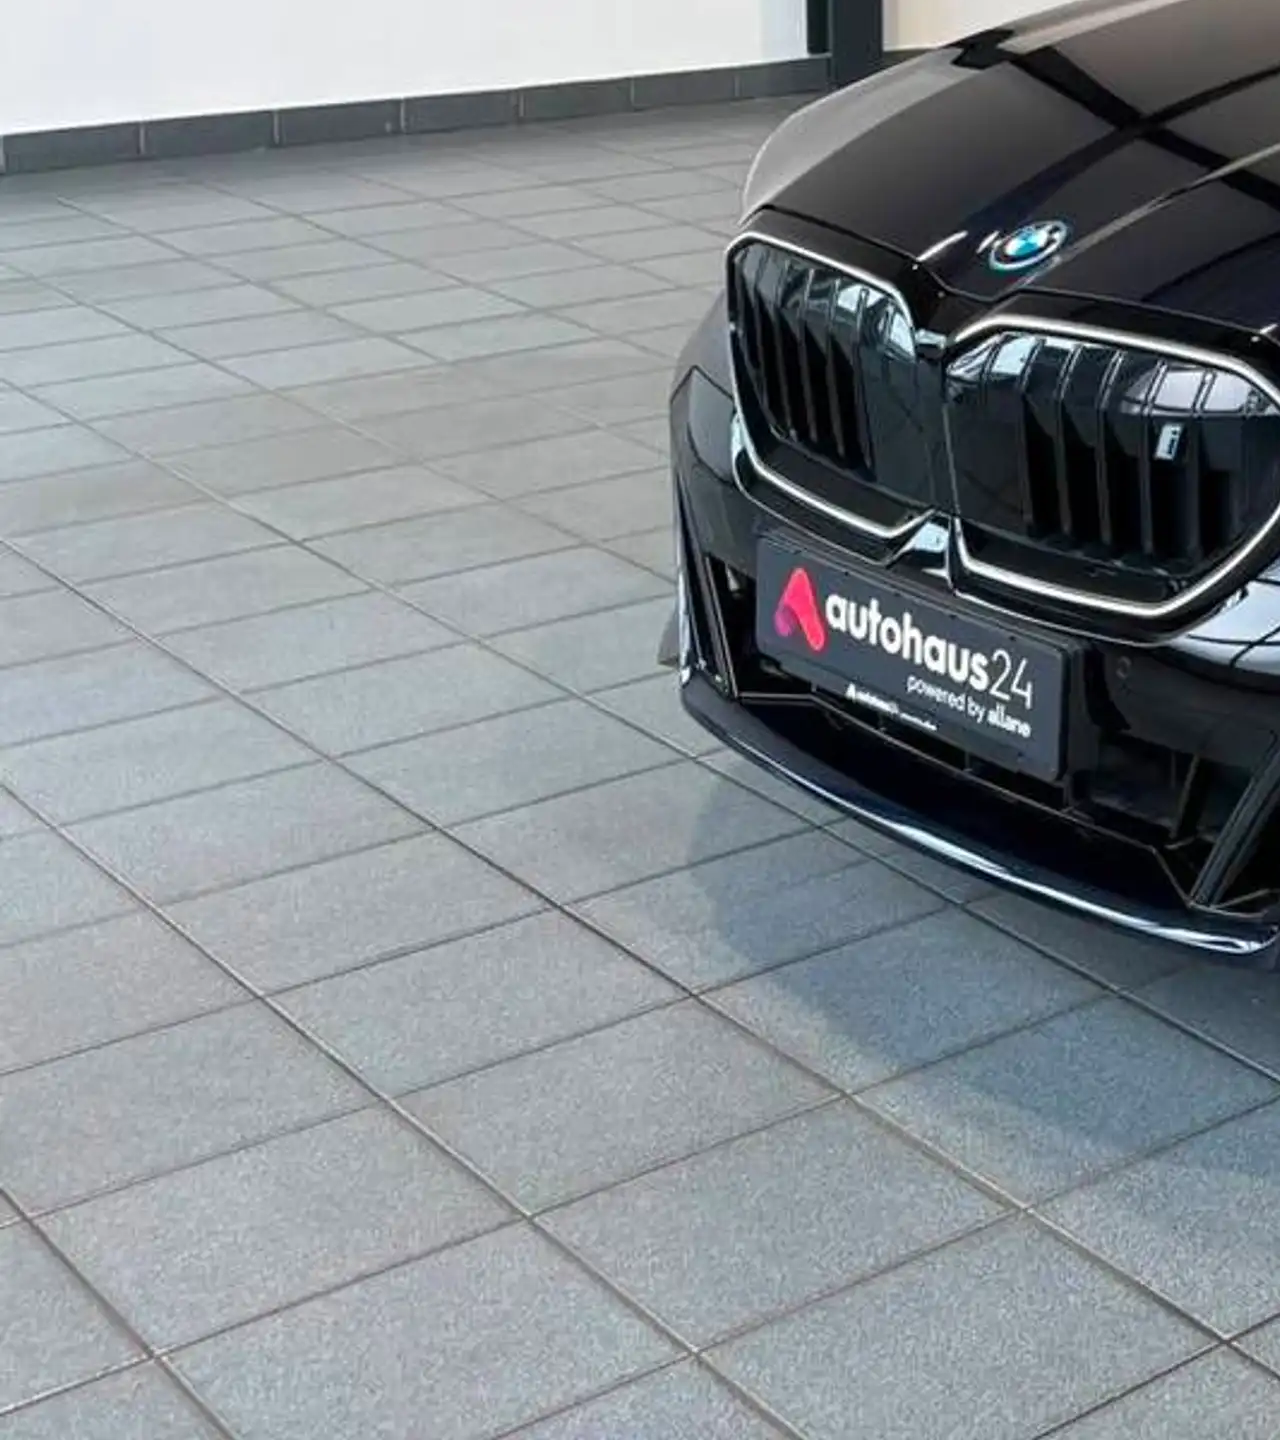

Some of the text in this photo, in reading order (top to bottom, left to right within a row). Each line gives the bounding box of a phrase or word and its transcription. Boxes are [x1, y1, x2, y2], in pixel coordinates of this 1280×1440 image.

[825, 593, 1032, 710] autohaus24
[906, 675, 966, 712] powered
[967, 695, 985, 724] by
